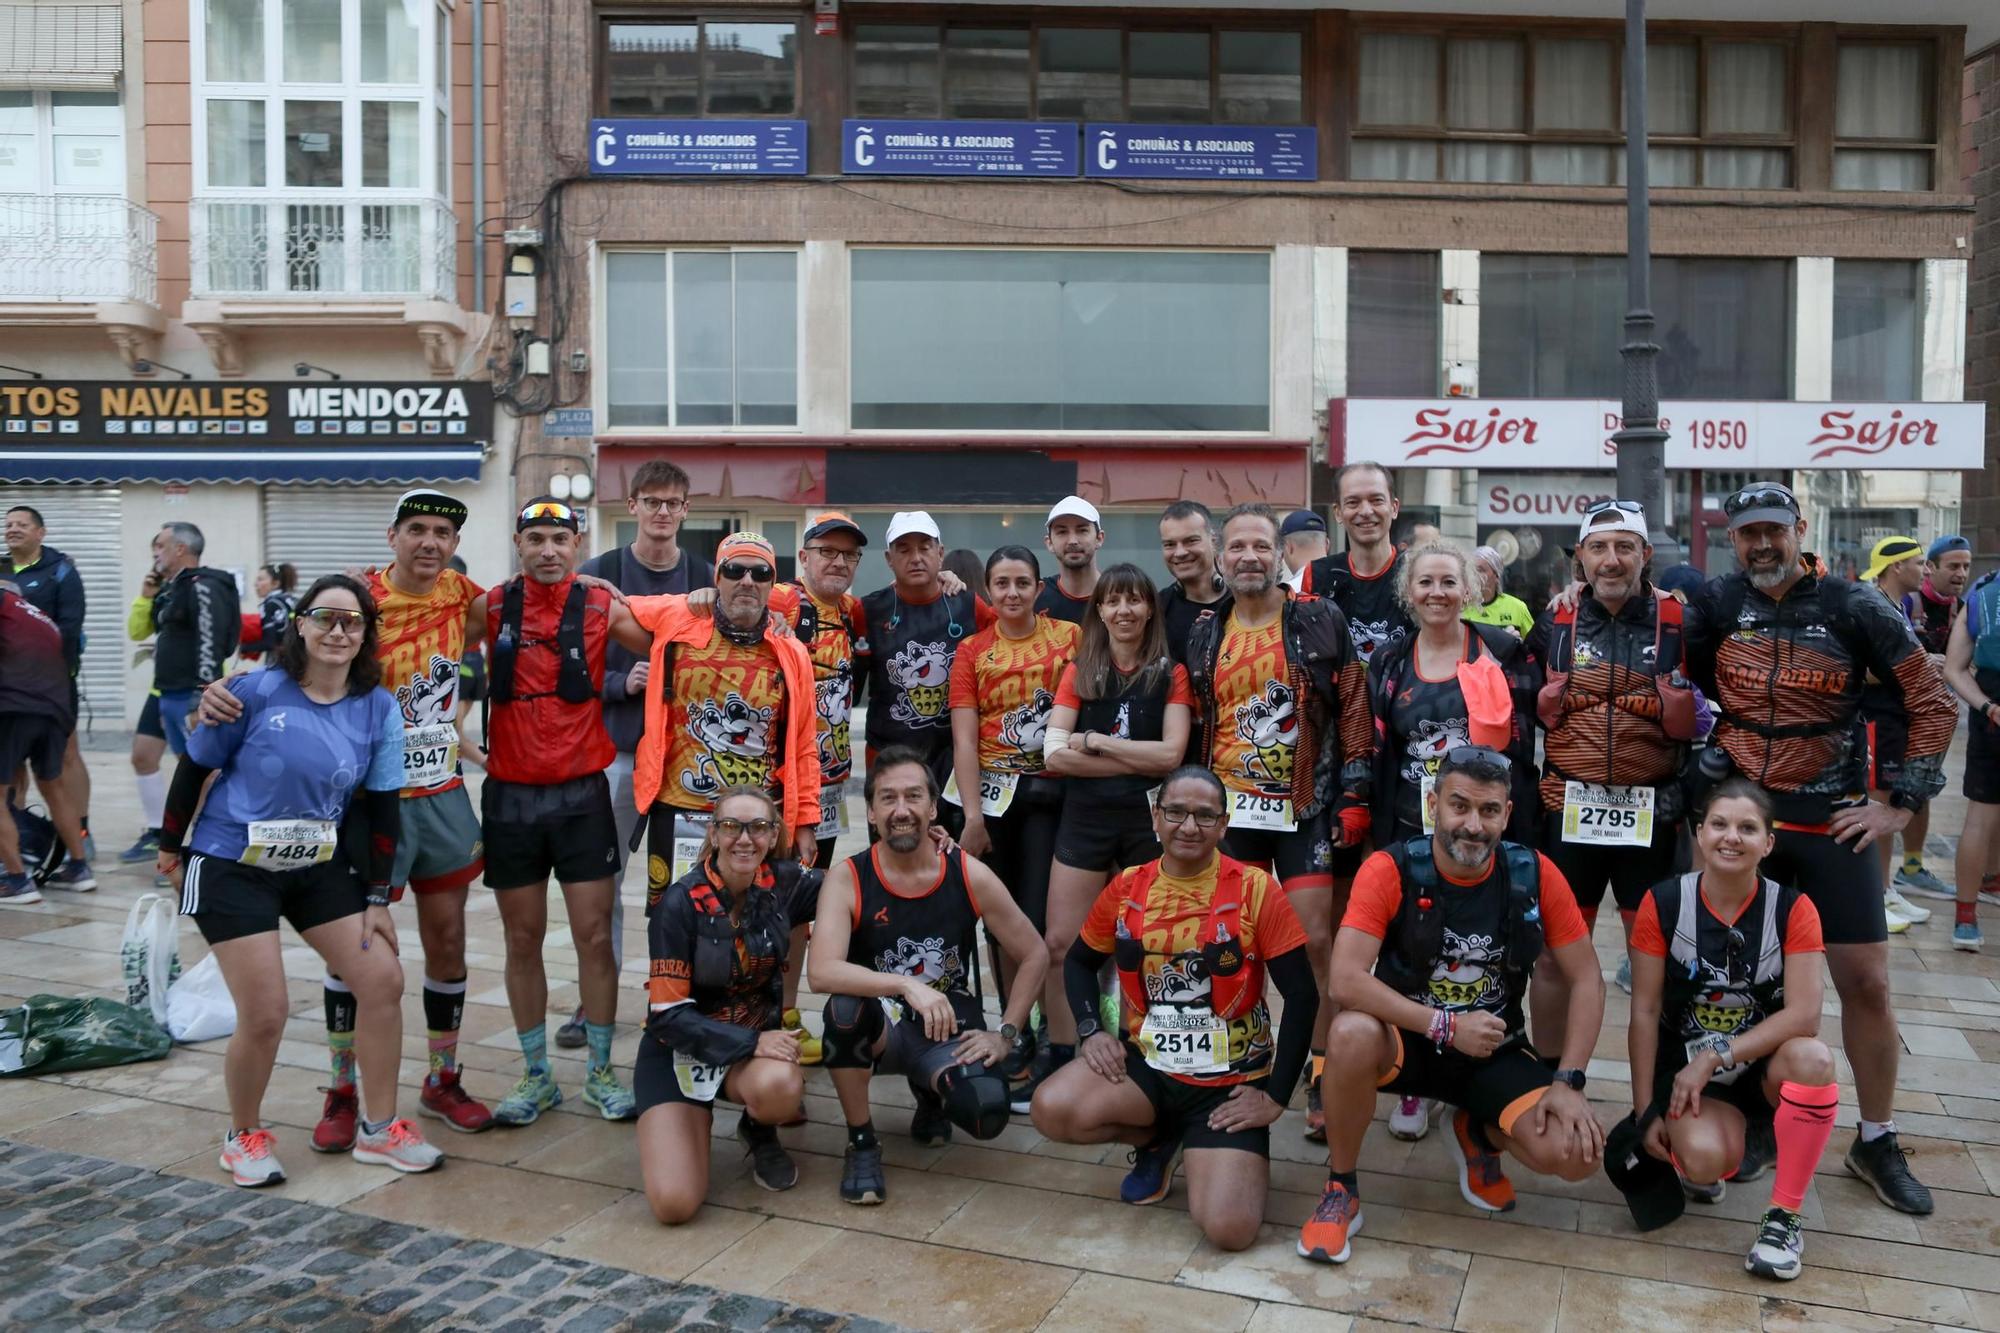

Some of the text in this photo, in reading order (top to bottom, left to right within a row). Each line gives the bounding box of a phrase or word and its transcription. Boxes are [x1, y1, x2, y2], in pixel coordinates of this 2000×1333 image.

[626, 132, 757, 147] COMUÑAS & ASOCIADOS
[885, 133, 1015, 148] COMUÑAS & ASOCIADOS
[1128, 137, 1255, 153] COMUÑAS & ASOCIADOS
[948, 154, 1015, 162] CONSULTORES
[1190, 158, 1255, 166] CONSULTORES
[0, 387, 470, 417] TOS NAVALES MENDOZA
[1401, 408, 1539, 459] Sajor
[1688, 420, 1747, 449] 1950
[1808, 410, 1939, 461] Sajor
[1489, 485, 1612, 514] Souve
[404, 747, 448, 769] 2947
[1236, 794, 1284, 813] 2783
[820, 806, 837, 822] 20
[1580, 807, 1636, 828] 2795
[266, 844, 319, 859] 1484
[1154, 1033, 1212, 1053] 2514
[1173, 1057, 1194, 1065] JAGUAR
